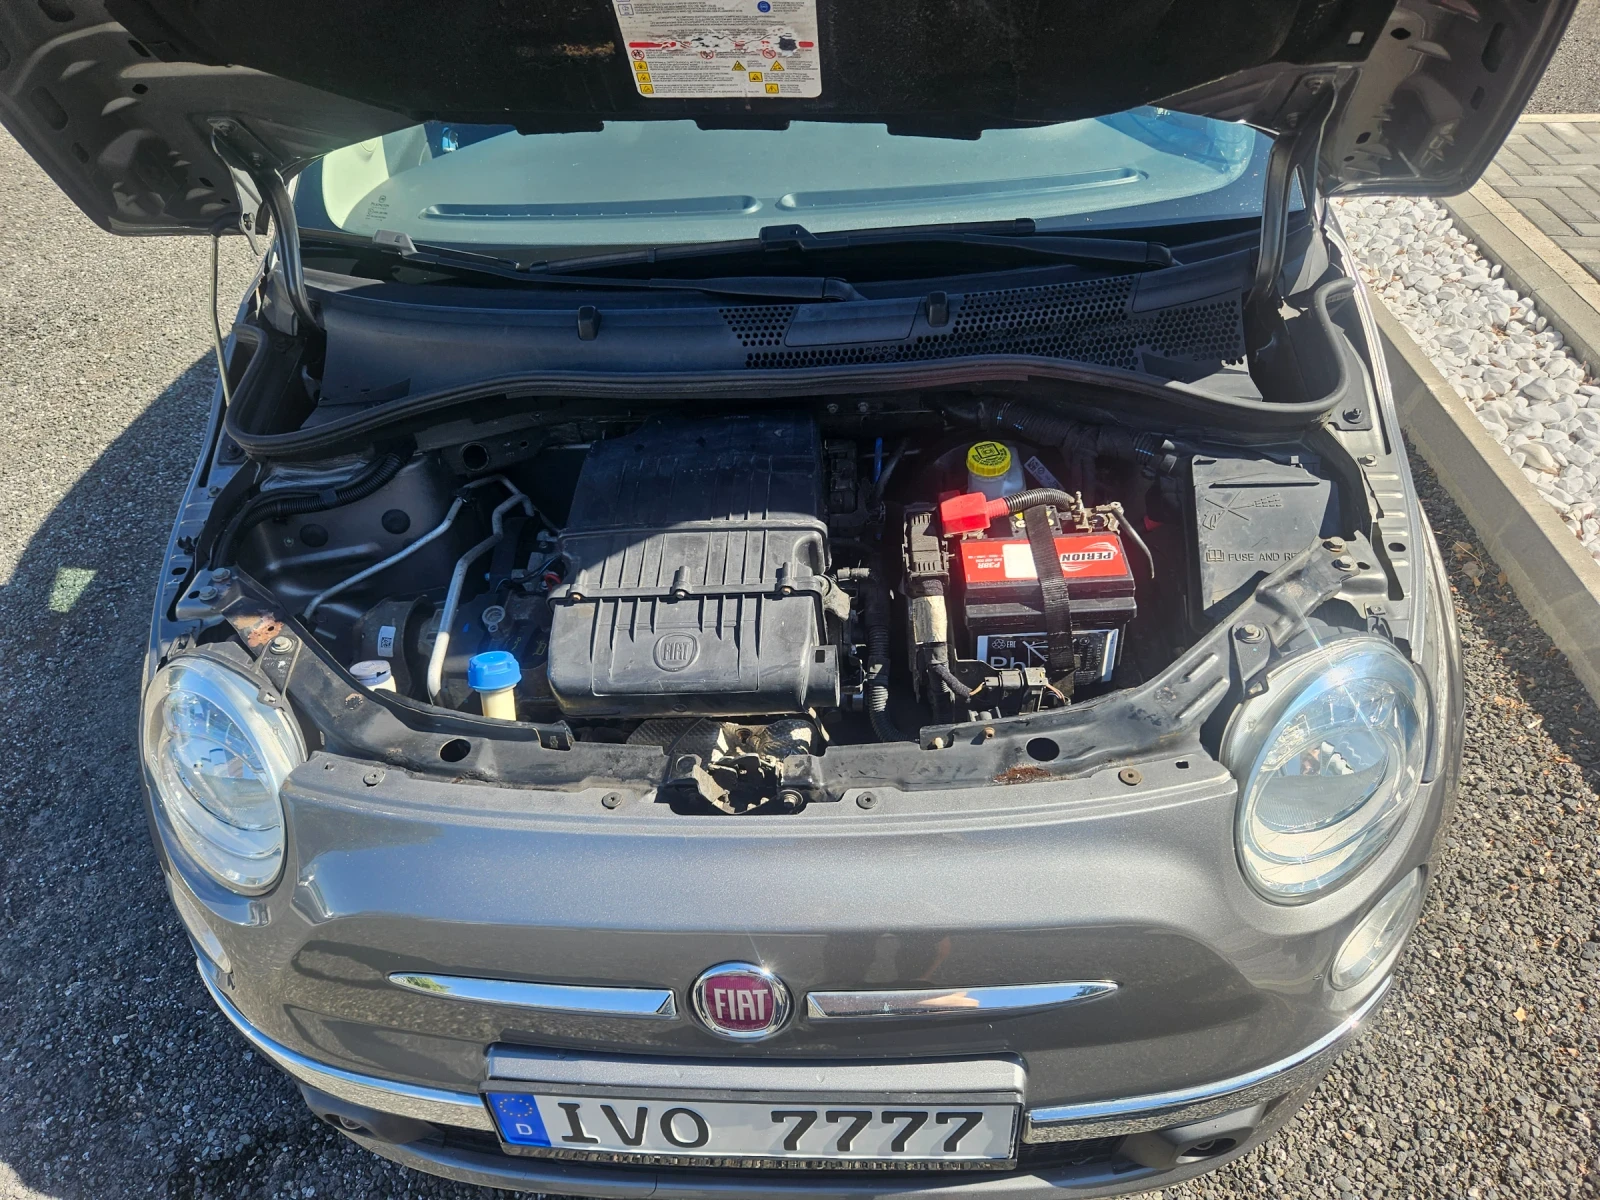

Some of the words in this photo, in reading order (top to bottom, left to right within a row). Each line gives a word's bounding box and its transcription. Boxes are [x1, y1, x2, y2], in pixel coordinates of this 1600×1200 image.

[1062, 552, 1111, 562] PERION
[1228, 553, 1255, 561] FUSE
[1259, 552, 1280, 561] AND
[663, 642, 691, 660] FIAT
[713, 988, 769, 1021] FIAT
[515, 1123, 533, 1136] D
[557, 1102, 710, 1149] IVO
[770, 1110, 984, 1152] 7777
